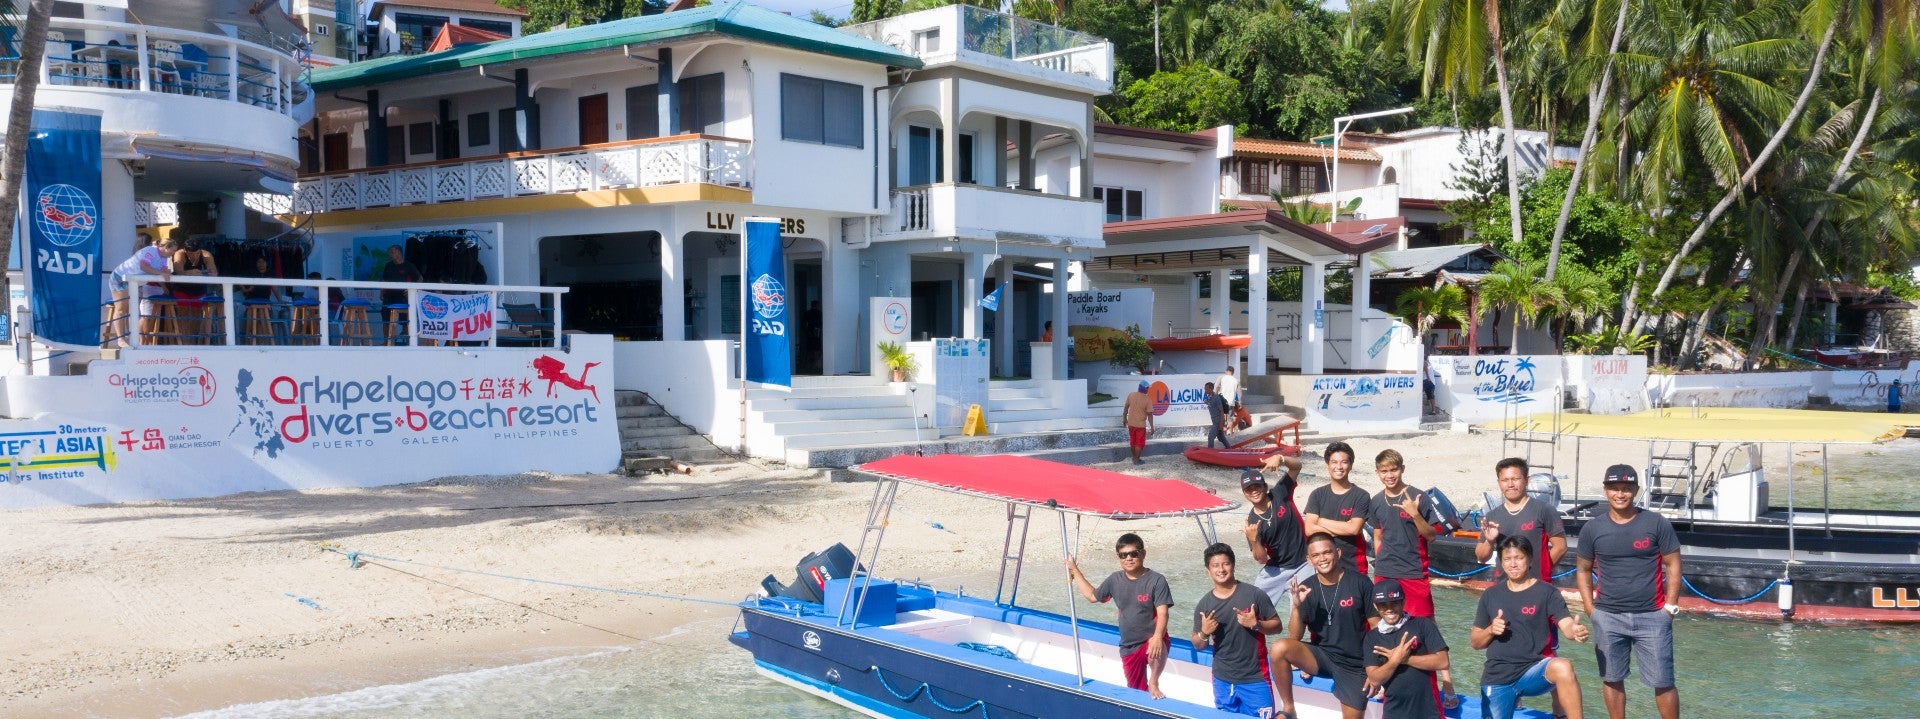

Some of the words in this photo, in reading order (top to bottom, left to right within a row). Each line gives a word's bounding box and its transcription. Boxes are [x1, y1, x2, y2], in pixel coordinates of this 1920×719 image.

[707, 211, 735, 230] LLV
[37, 248, 94, 276] PADI
[451, 293, 489, 313] Diving
[1068, 293, 1093, 304] Paddle
[1097, 291, 1121, 303] Board
[1081, 303, 1109, 316] Kayaks
[422, 321, 448, 331] PADI
[453, 310, 492, 339] FUN
[752, 318, 785, 337] PAD
[1475, 359, 1509, 376] Out
[109, 373, 197, 389] arkipelagos
[1313, 377, 1347, 390] ACTION
[1384, 377, 1415, 388] DIVERS
[1473, 382, 1482, 395] of
[1494, 374, 1531, 393] Blue
[124, 386, 180, 399] kitchen
[269, 375, 457, 410] arkipelago
[460, 377, 533, 400] 千岛潜水
[1156, 389, 1169, 403] LA
[59, 424, 73, 434] 30
[74, 426, 107, 434] meters
[280, 405, 393, 443] divers
[56, 436, 95, 453] ASIA
[118, 427, 165, 452] 千岛
[194, 440, 221, 448] RESORT
[313, 439, 374, 449] PUERTO
[401, 435, 459, 445] GALERA
[494, 428, 578, 440] PHILIPPINES
[0, 473, 32, 483] Diers
[38, 469, 85, 480] Institute
[1521, 521, 1535, 531] ad
[1633, 537, 1649, 549] ad
[1137, 593, 1149, 602] ad
[1340, 596, 1354, 607] ad
[1872, 587, 1920, 607] LL
[1521, 605, 1536, 615] ad
[1258, 707, 1272, 719] 17
